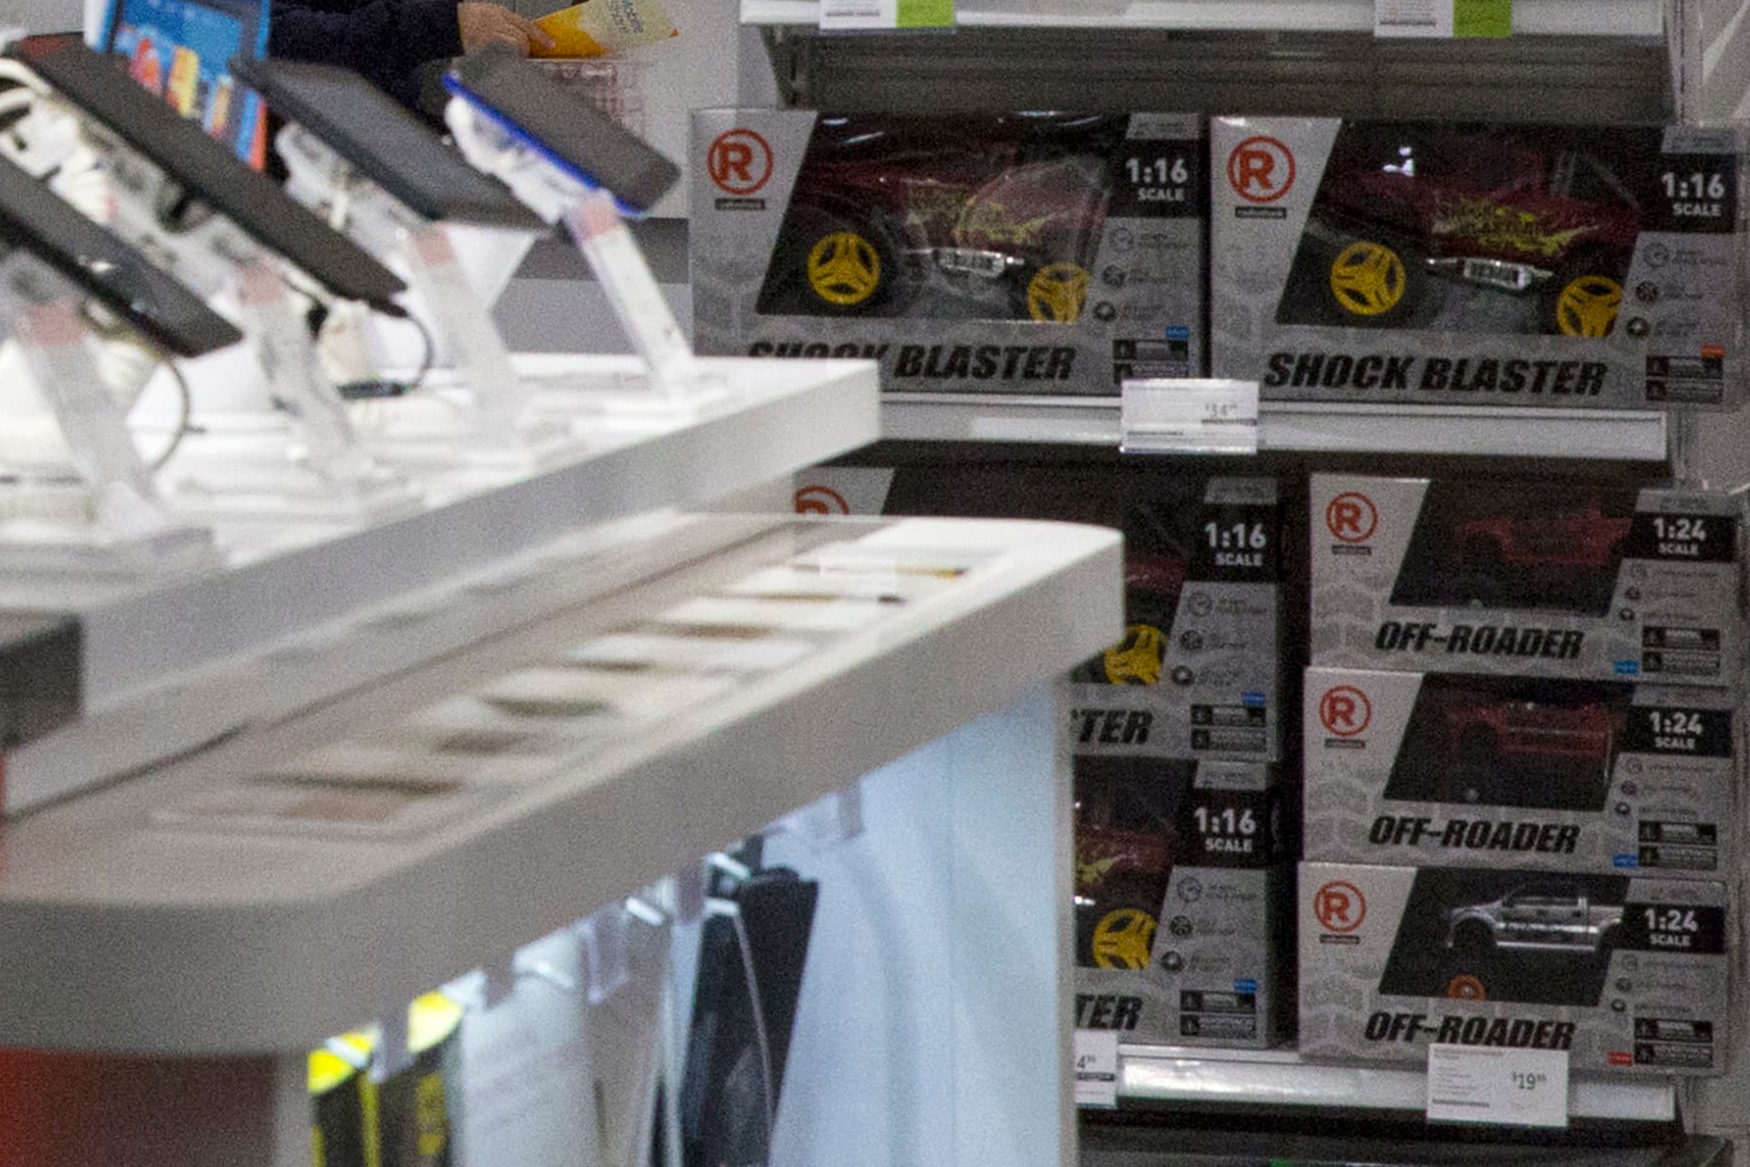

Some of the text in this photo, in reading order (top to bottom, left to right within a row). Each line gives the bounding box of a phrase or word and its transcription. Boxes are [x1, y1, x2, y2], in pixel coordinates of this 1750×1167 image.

[1125, 157, 1189, 184] 1:16
[1137, 188, 1185, 201] SCALE
[1660, 172, 1726, 200] 1:16
[1672, 203, 1722, 218] SCALE
[893, 343, 1079, 382] BLASTER
[1263, 350, 1415, 391] SHOCK
[1418, 355, 1609, 397] BLASTER
[1205, 522, 1267, 549] 1:16
[1653, 517, 1707, 543] 1:24
[1215, 552, 1263, 567] SCALE
[1658, 543, 1700, 557] SCALE
[1375, 620, 1587, 661] OFF-ROADER
[1650, 711, 1703, 736] 1:24
[1654, 737, 1696, 751] SCALE
[1194, 806, 1257, 835] 1:16
[1204, 837, 1253, 853] SCALE
[1368, 814, 1581, 855] OFF-ROADER
[1644, 907, 1698, 932] 1:24
[1649, 934, 1691, 948] SCALE
[1364, 1011, 1577, 1051] OFF-ROADER
